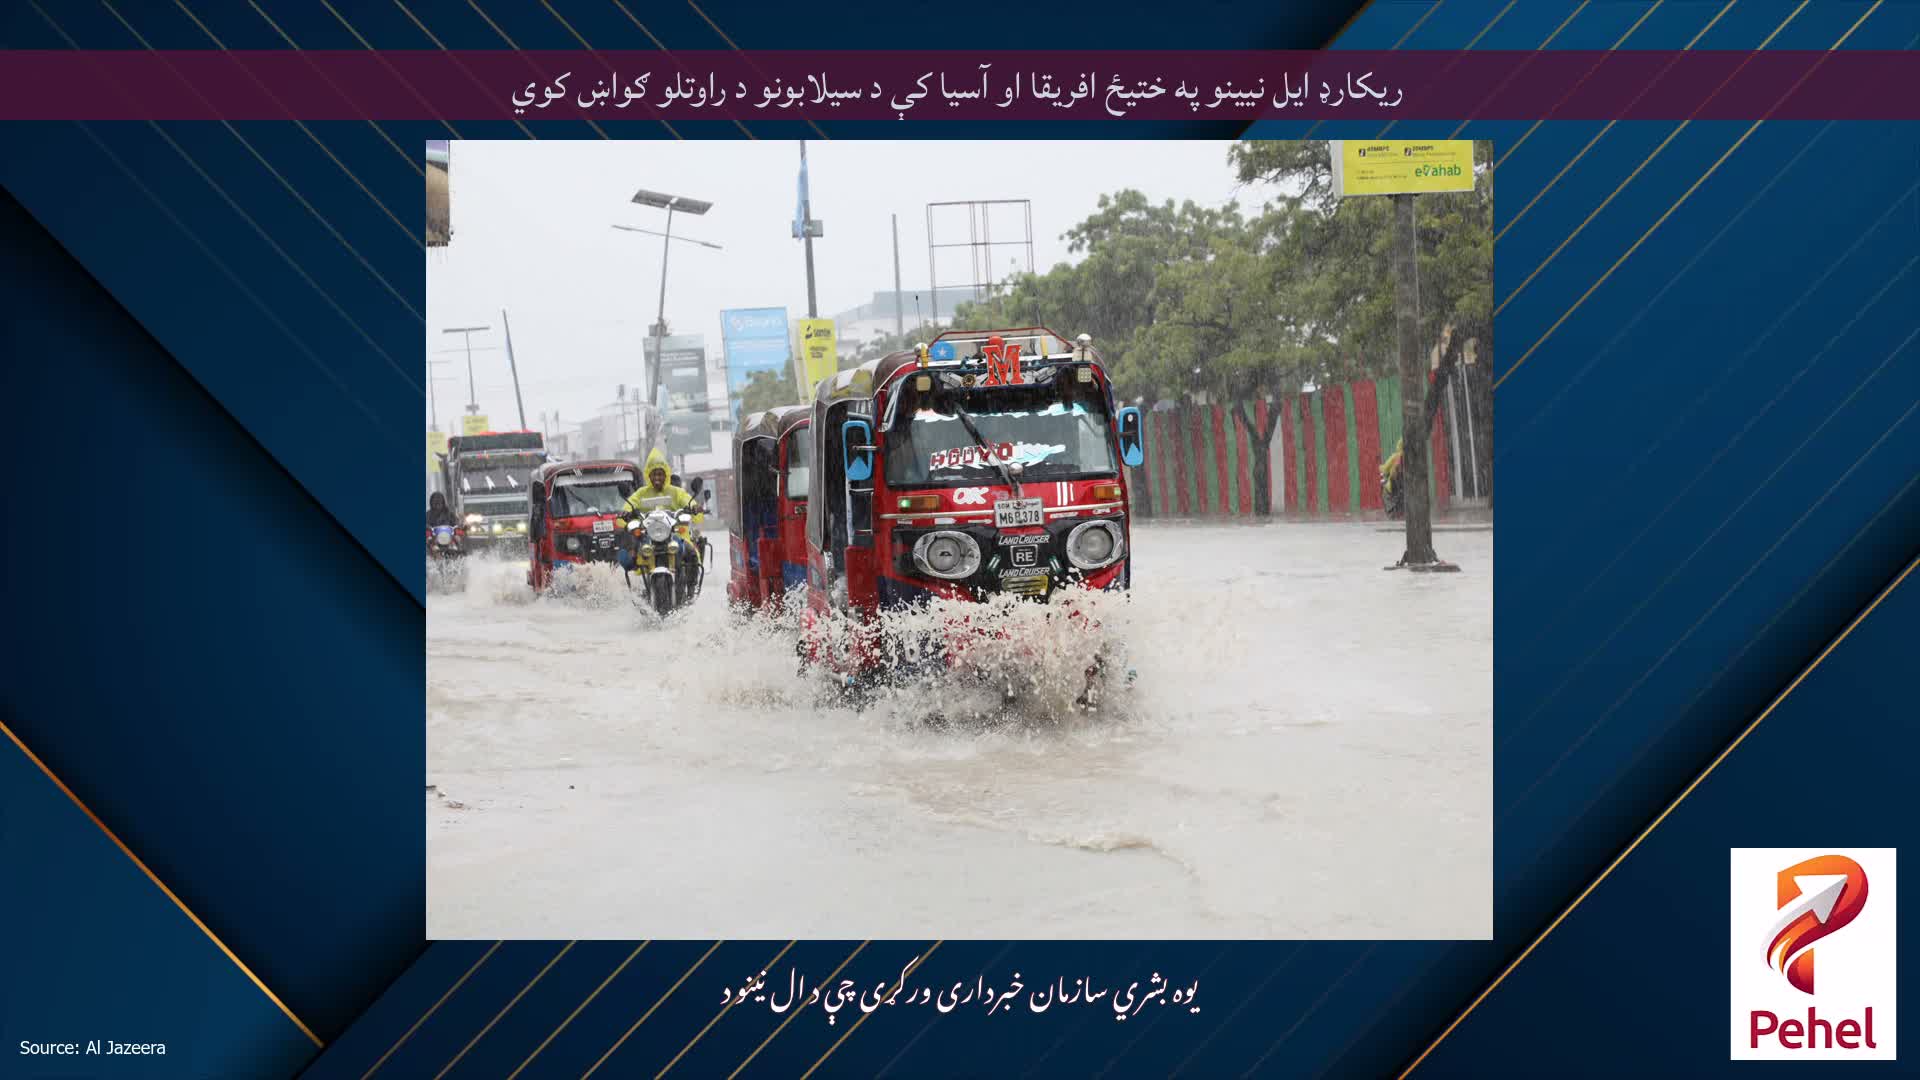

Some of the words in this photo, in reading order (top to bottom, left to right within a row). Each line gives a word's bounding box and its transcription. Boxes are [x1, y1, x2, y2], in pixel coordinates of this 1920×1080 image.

[981, 343, 1024, 387] M
[998, 535, 1020, 545] LAND
[1018, 534, 1050, 544] CRUISER
[1015, 552, 1034, 563] RE
[999, 568, 1020, 577] LAND
[1018, 566, 1050, 577] CRUISER
